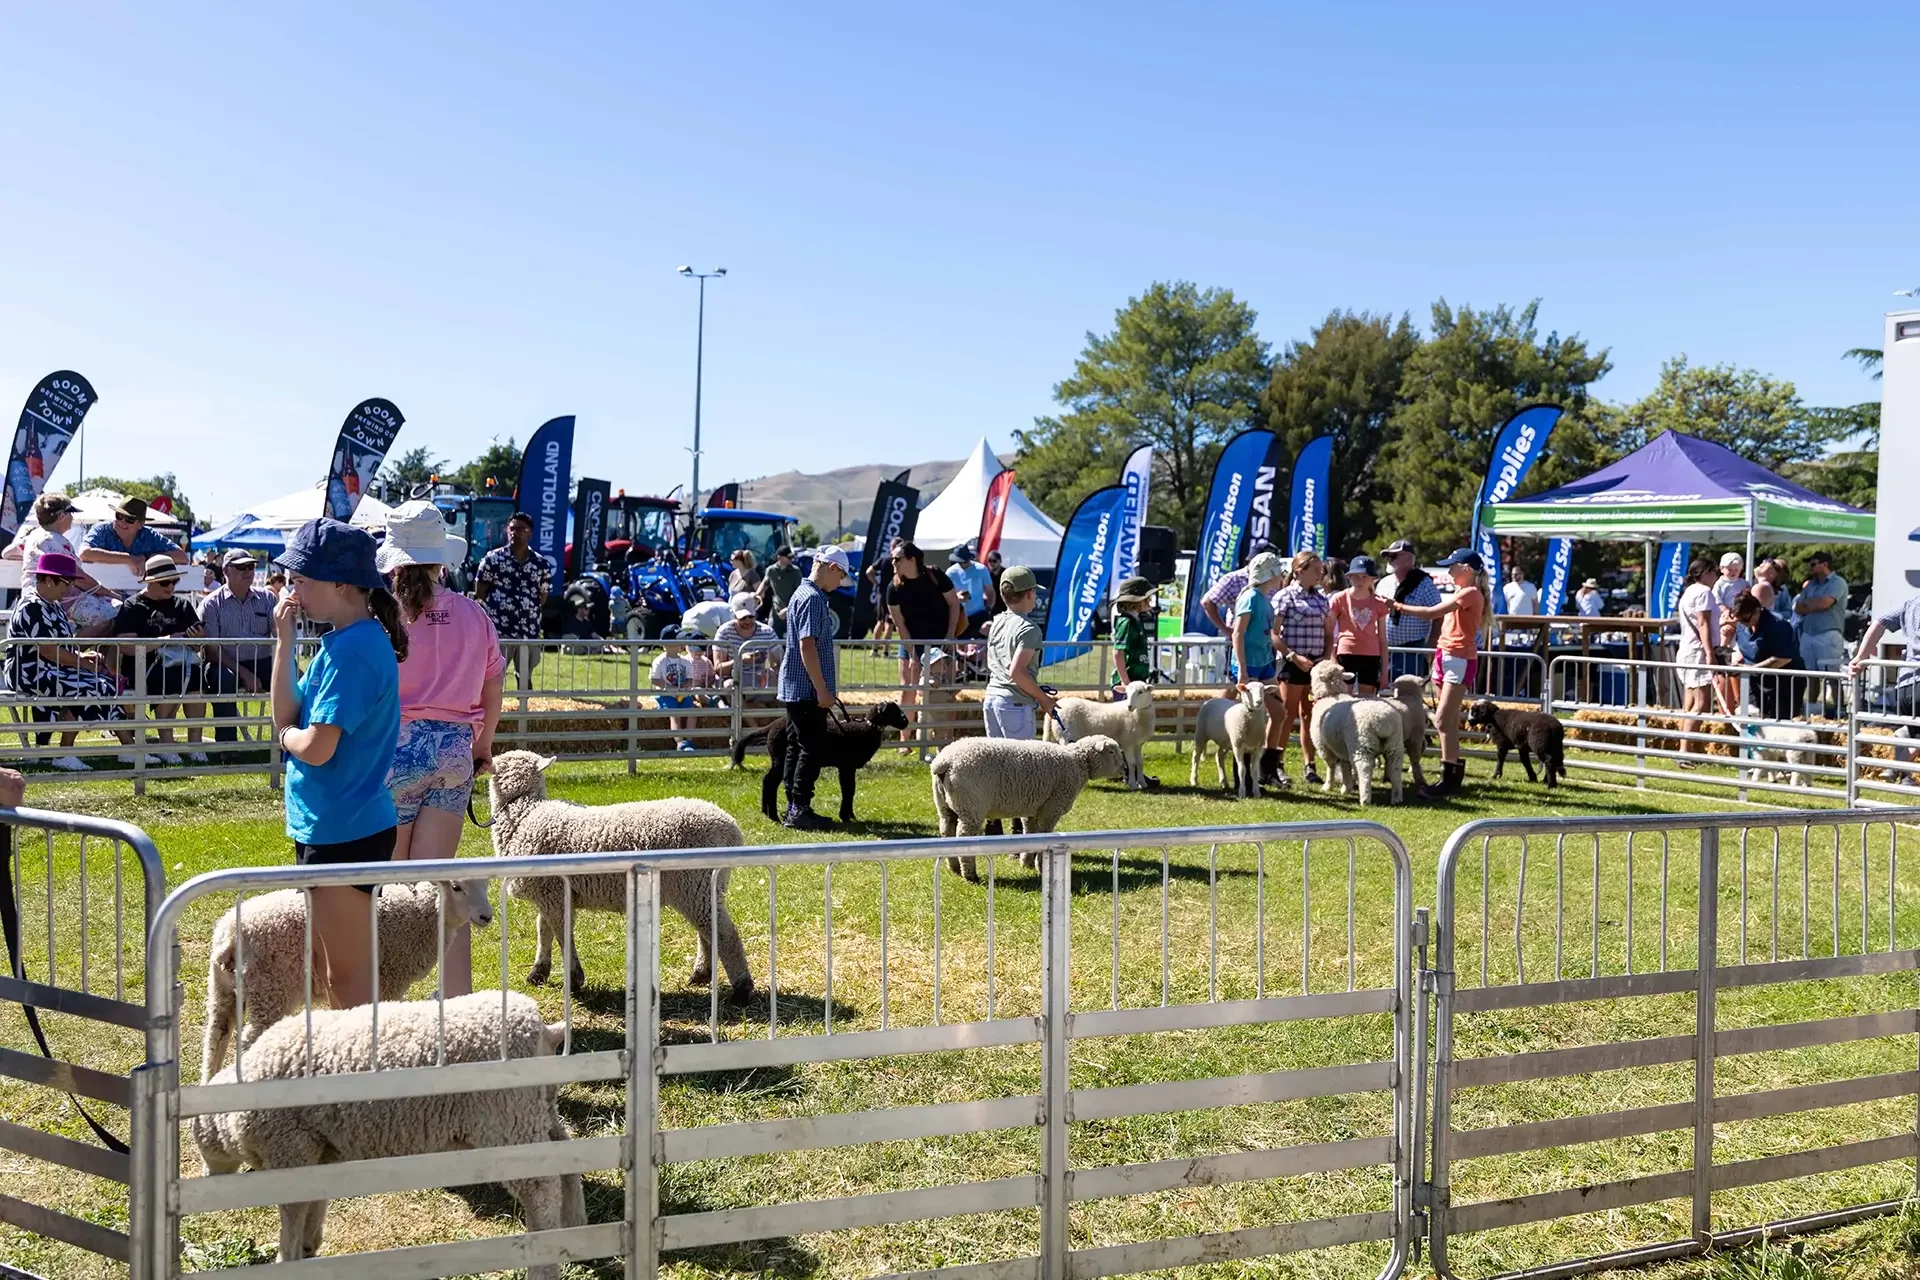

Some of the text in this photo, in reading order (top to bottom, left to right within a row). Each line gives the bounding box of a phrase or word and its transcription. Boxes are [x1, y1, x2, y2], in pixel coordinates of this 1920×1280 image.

[40, 387, 85, 417] BREWING CO
[52, 379, 88, 405] BOOM
[39, 400, 73, 425] TOWN
[364, 406, 396, 428] BOOM
[353, 424, 384, 447] TOWN
[384, 430, 395, 439] CO
[540, 440, 560, 551] NEW HOLLAND
[1211, 472, 1242, 562] Wrightson
[1081, 512, 1110, 604] Wrightson
[1221, 524, 1241, 572] Estate
